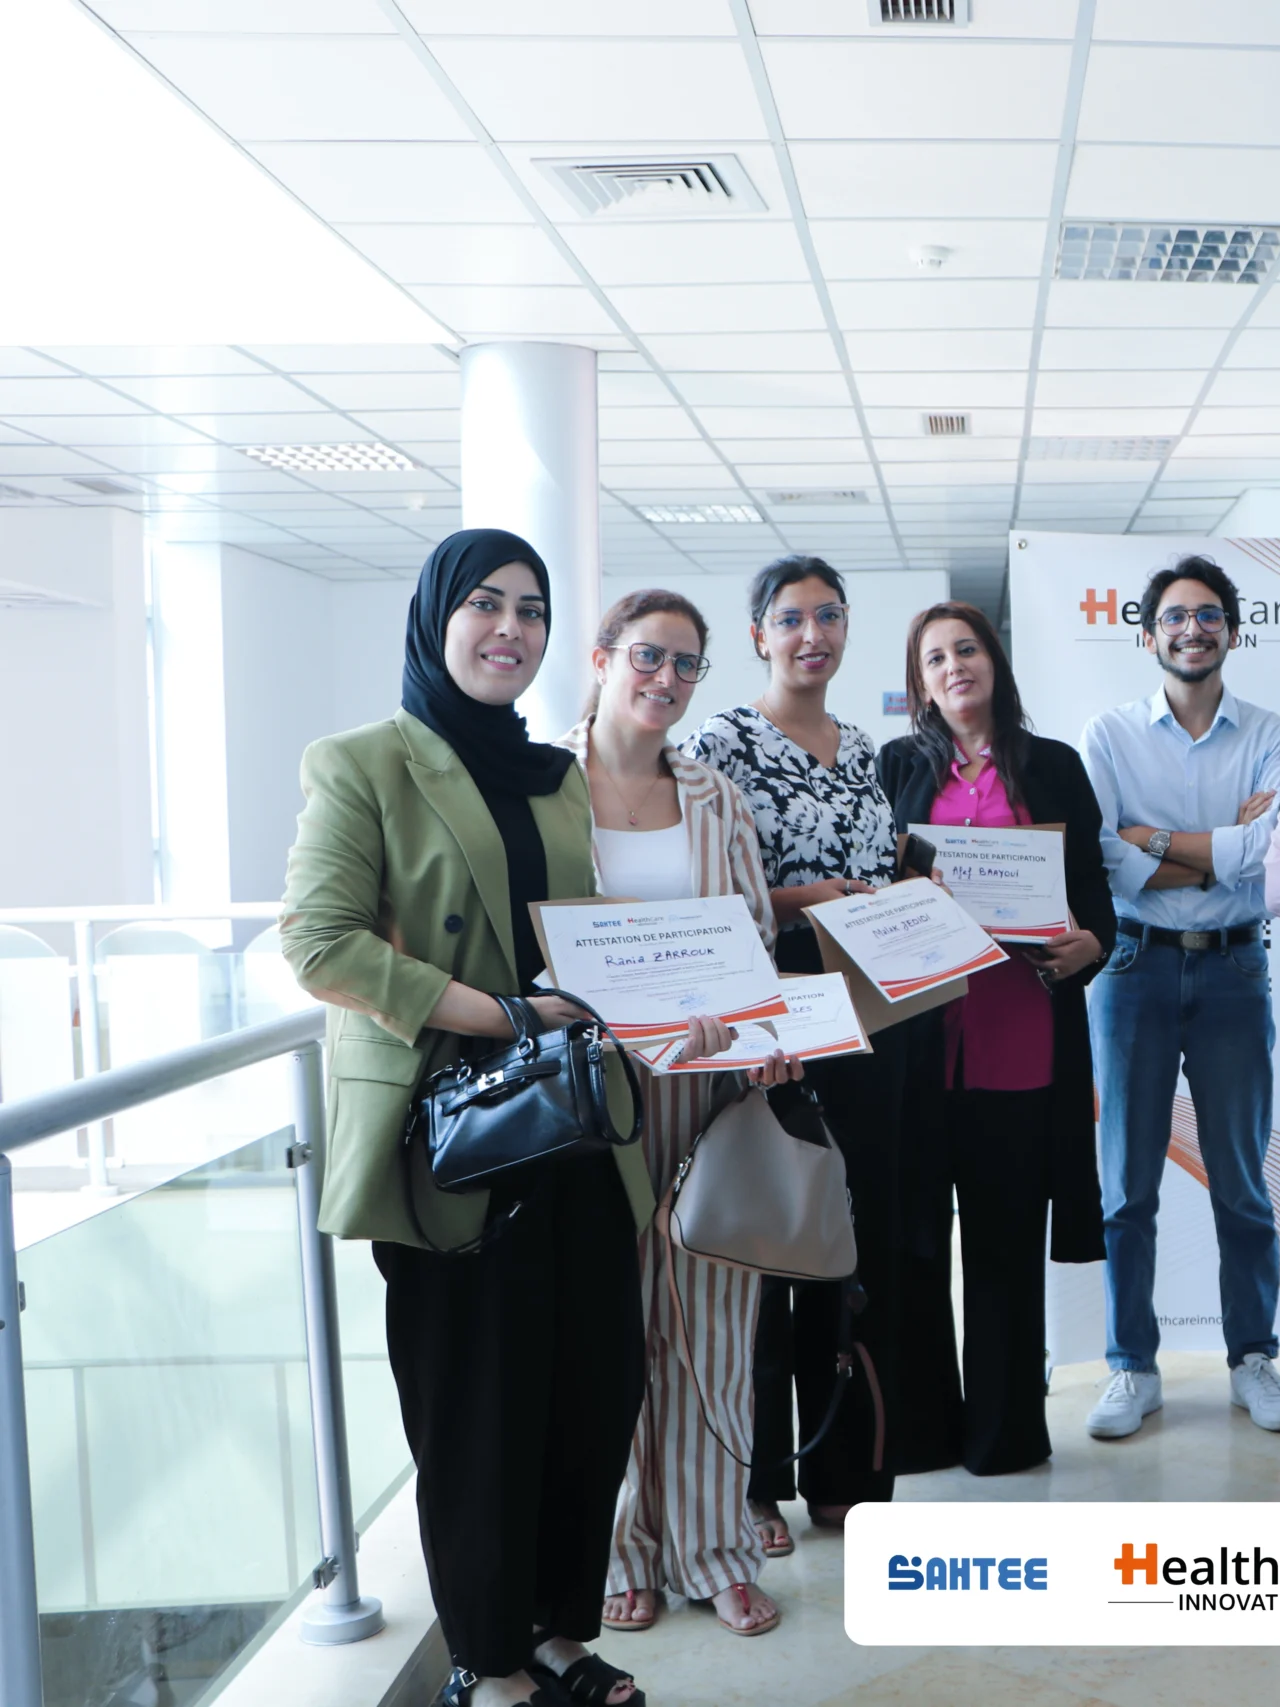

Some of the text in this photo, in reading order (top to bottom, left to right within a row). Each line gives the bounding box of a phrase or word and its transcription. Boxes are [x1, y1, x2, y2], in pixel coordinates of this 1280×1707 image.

[937, 850, 979, 859] TESTATION
[991, 853, 1047, 863] PARTICIPATION
[575, 925, 733, 948] ATTESTATION DE PARTICIPATION
[604, 954, 645, 968] Rania
[788, 992, 825, 1001] IPATION
[1157, 1314, 1223, 1327] thcareinno
